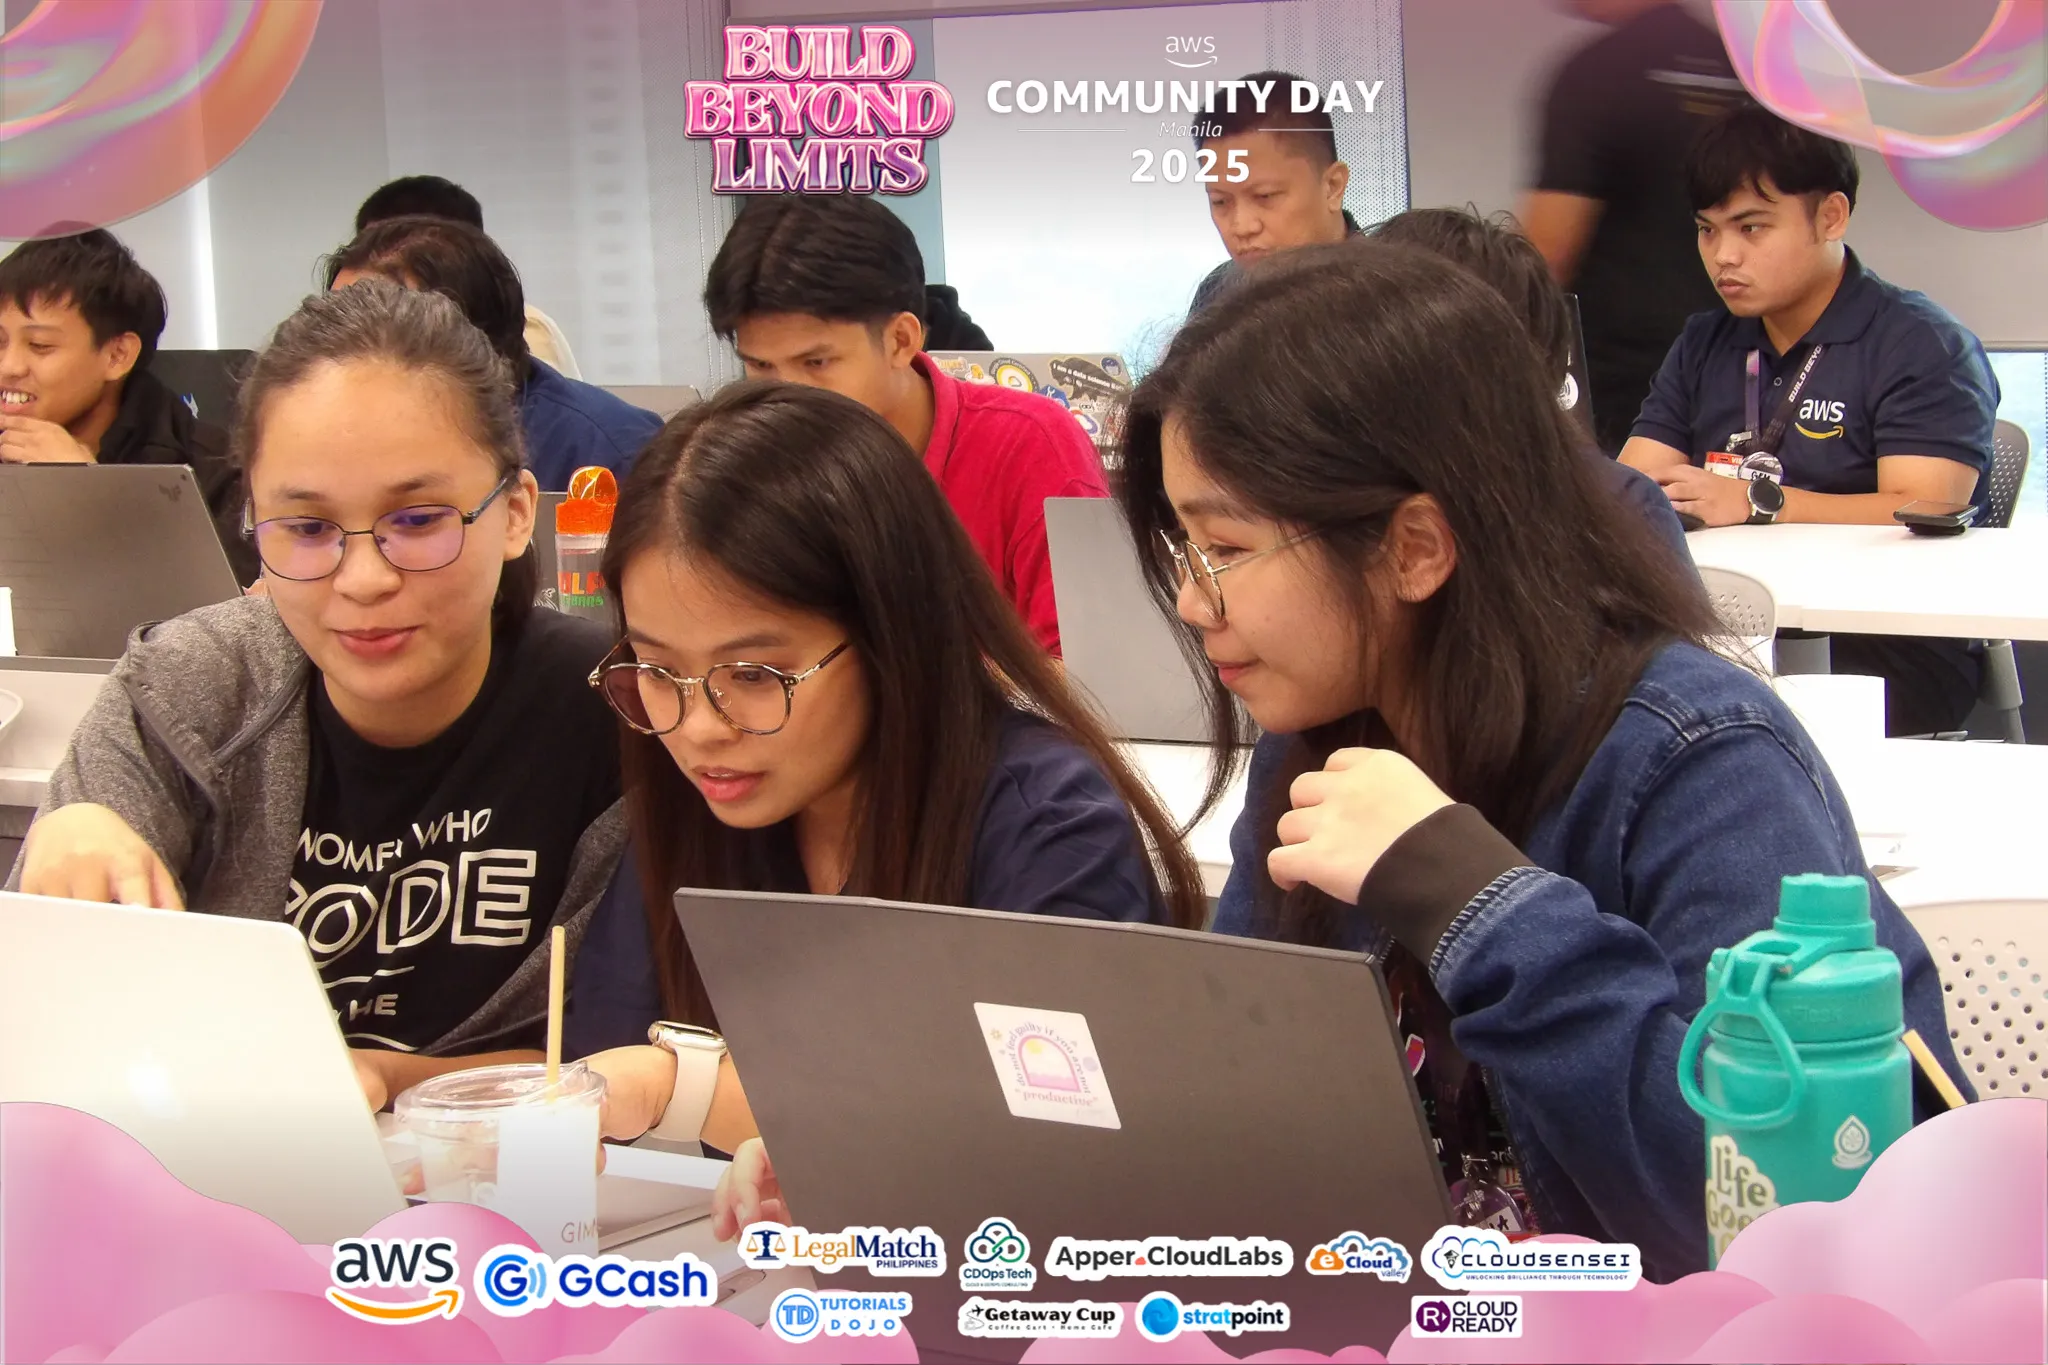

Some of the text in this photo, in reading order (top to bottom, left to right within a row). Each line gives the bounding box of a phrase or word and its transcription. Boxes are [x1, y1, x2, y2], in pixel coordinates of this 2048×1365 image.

[1799, 398, 1846, 423] aws
[411, 807, 493, 850] WHO
[284, 848, 538, 970] ODE
[333, 993, 399, 1022] HE
[1056, 1036, 1073, 1054] you
